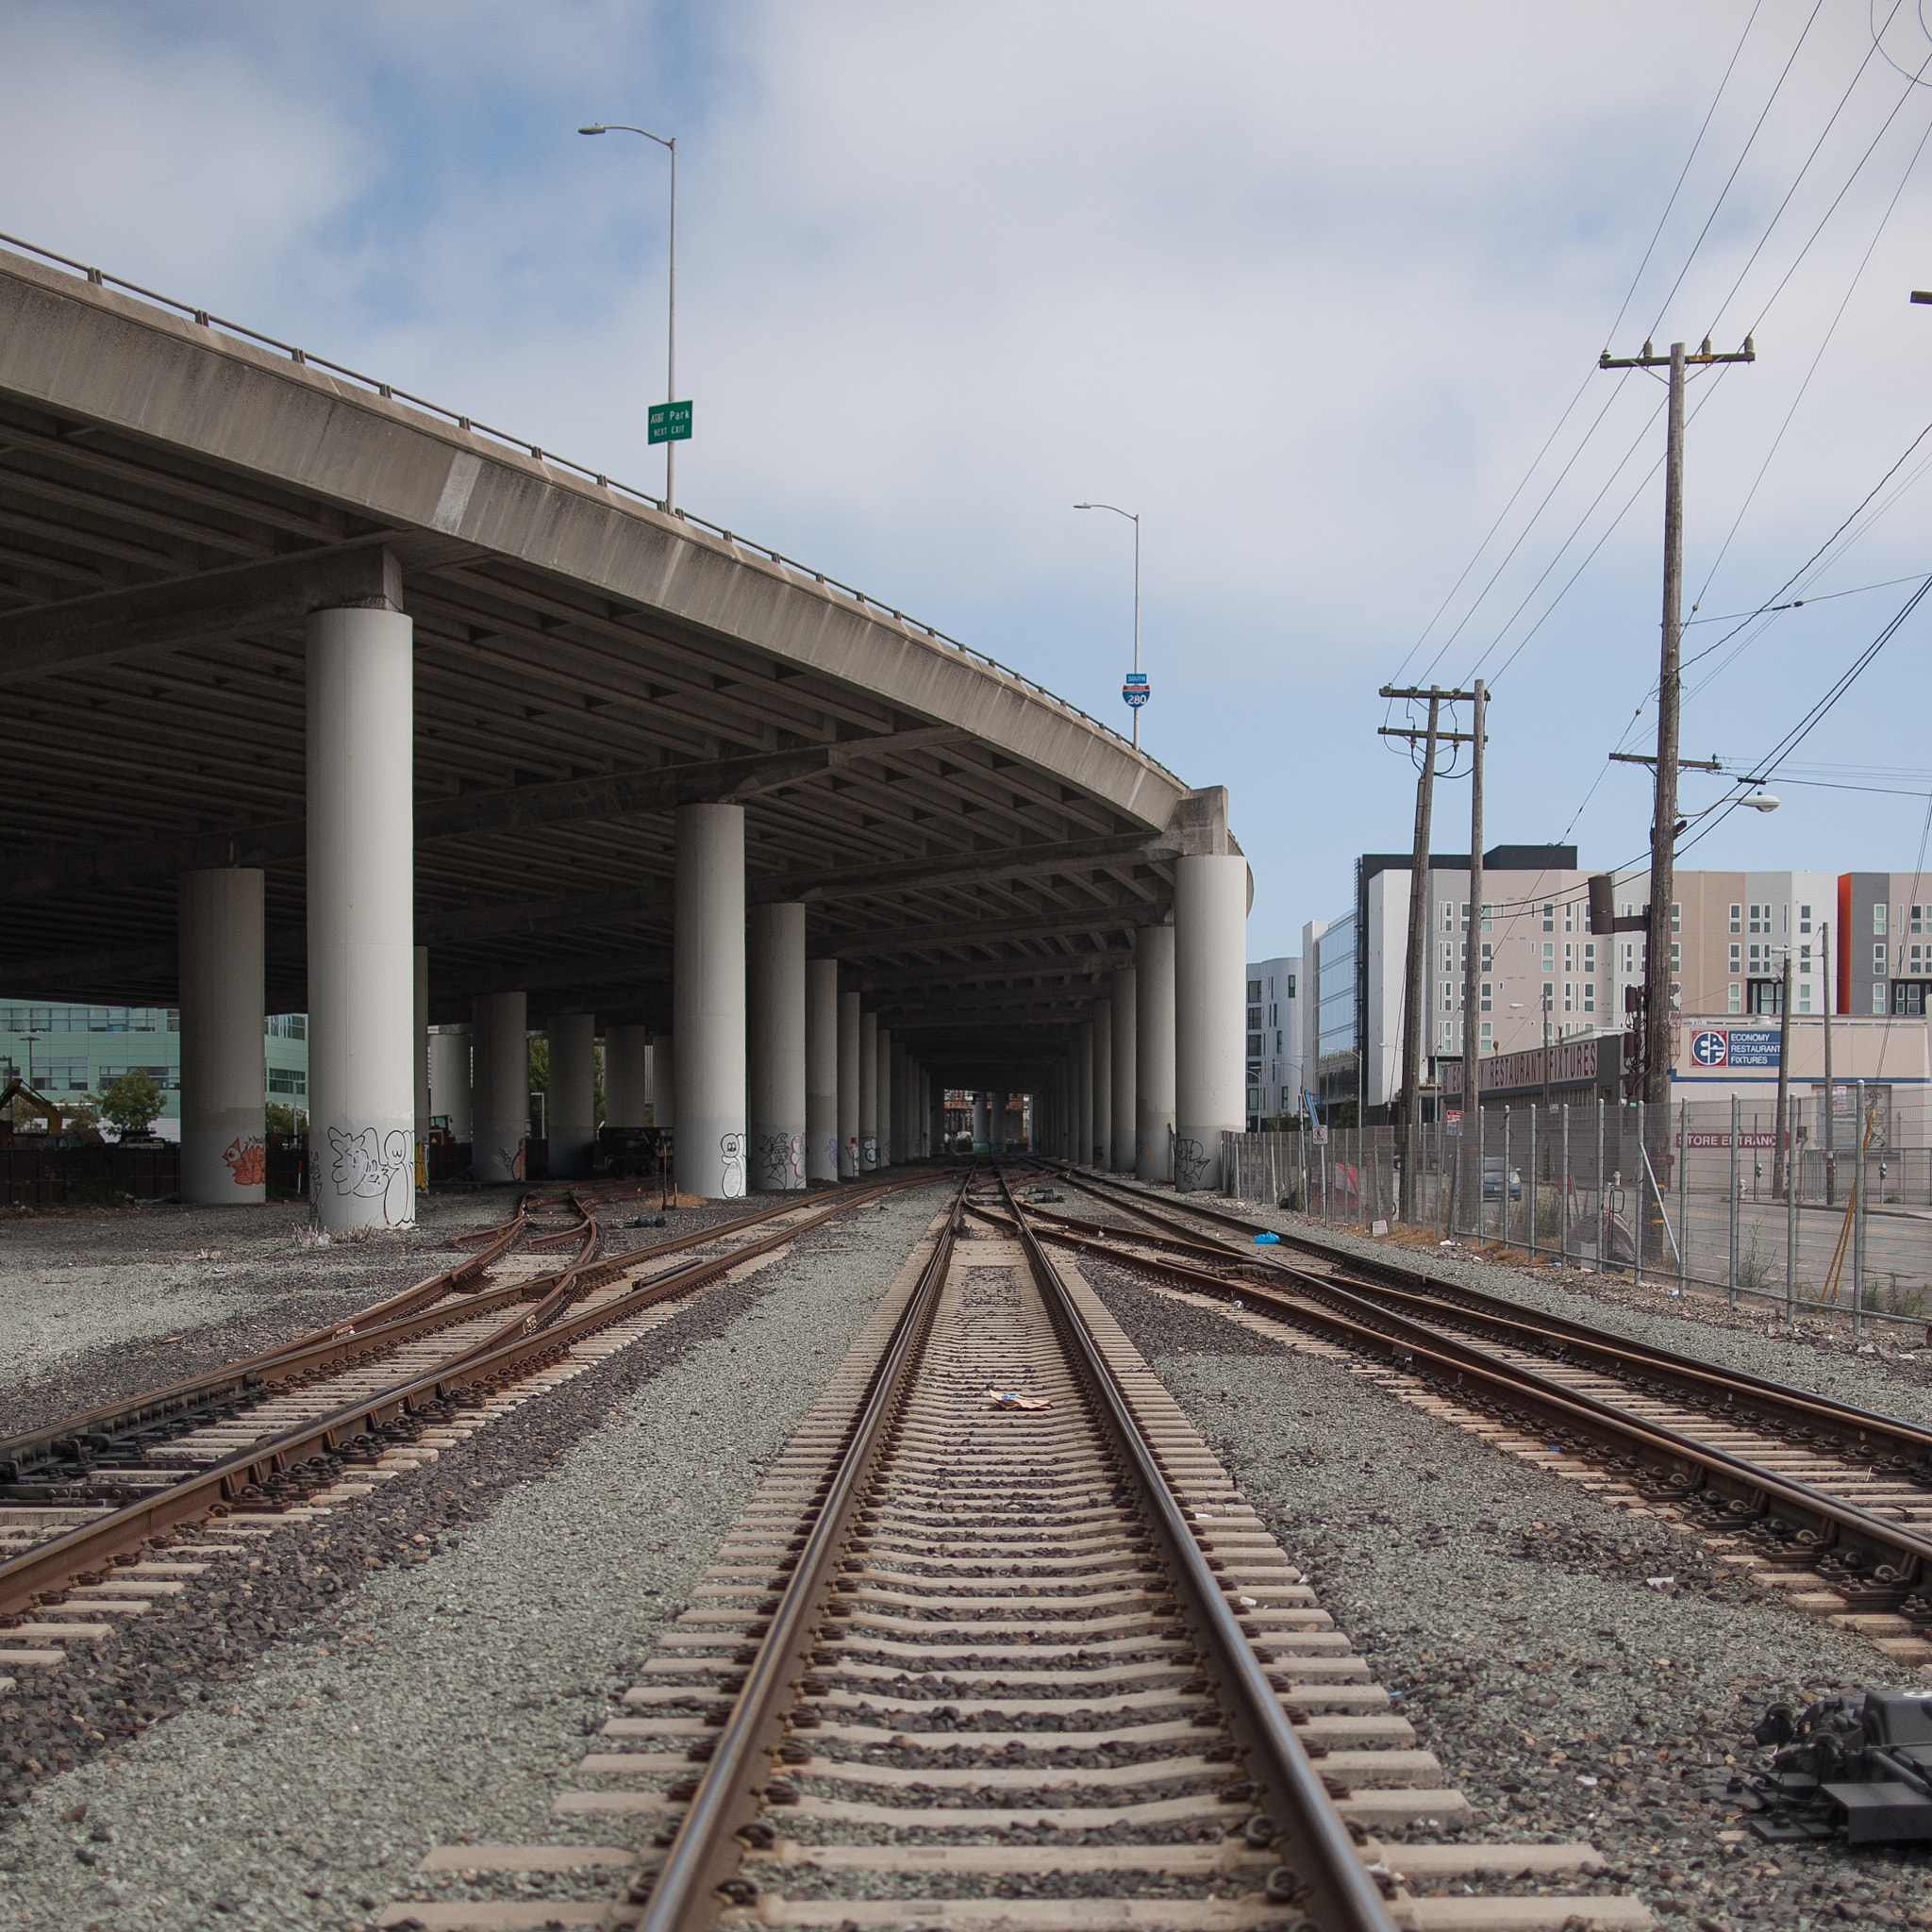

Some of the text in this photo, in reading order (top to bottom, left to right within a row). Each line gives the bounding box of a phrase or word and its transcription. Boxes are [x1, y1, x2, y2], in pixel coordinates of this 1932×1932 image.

[669, 409, 690, 421] Park
[654, 425, 685, 436] NEXT EXIT
[1127, 694, 1146, 705] 280
[1730, 1033, 1770, 1041] ECONOMY
[1730, 1044, 1780, 1054] RESTAURANT
[1491, 1052, 1541, 1087] RESTAURANT
[1549, 1042, 1596, 1080] FIXTURES
[1722, 1135, 1777, 1146] ETRANC
